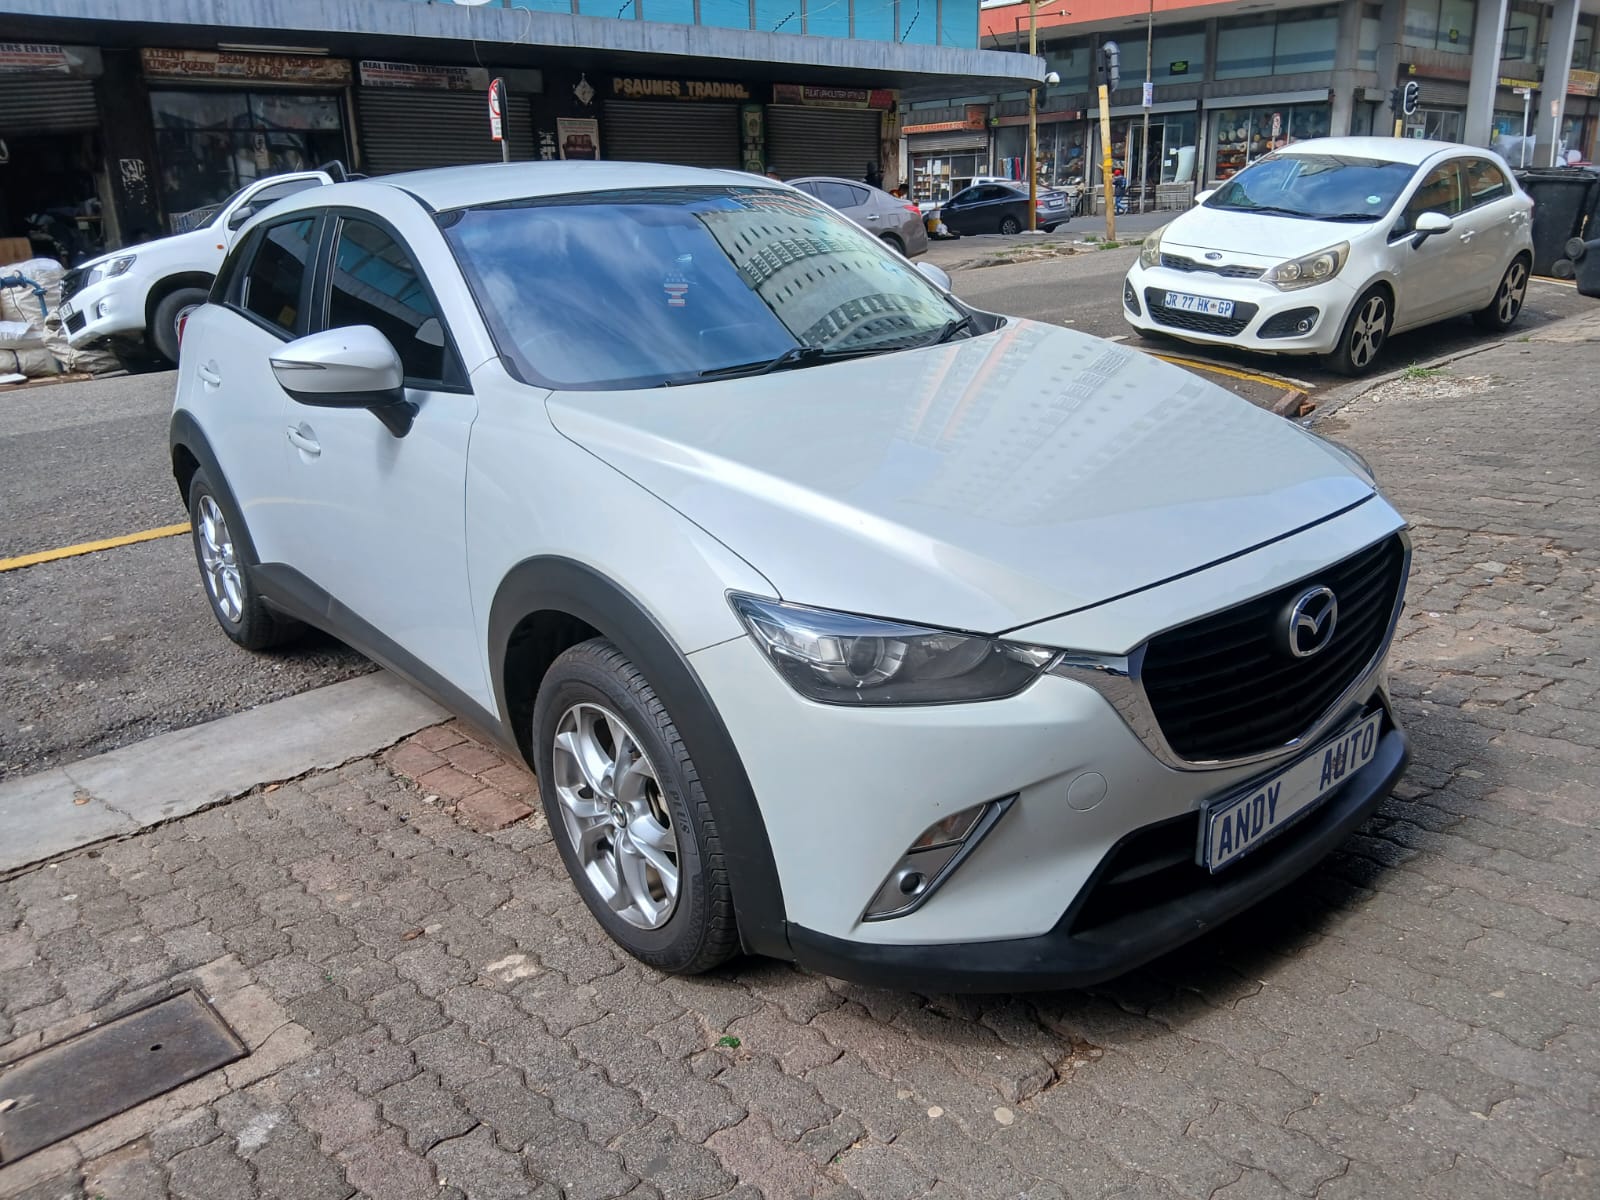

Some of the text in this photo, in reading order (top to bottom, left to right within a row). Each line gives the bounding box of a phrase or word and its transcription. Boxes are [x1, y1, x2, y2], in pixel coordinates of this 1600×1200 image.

[362, 61, 381, 69] REAL
[613, 77, 681, 96] PSAUMES
[1166, 293, 1231, 315] JR 77 HK GP
[1217, 722, 1374, 860] ANDY AUTO
